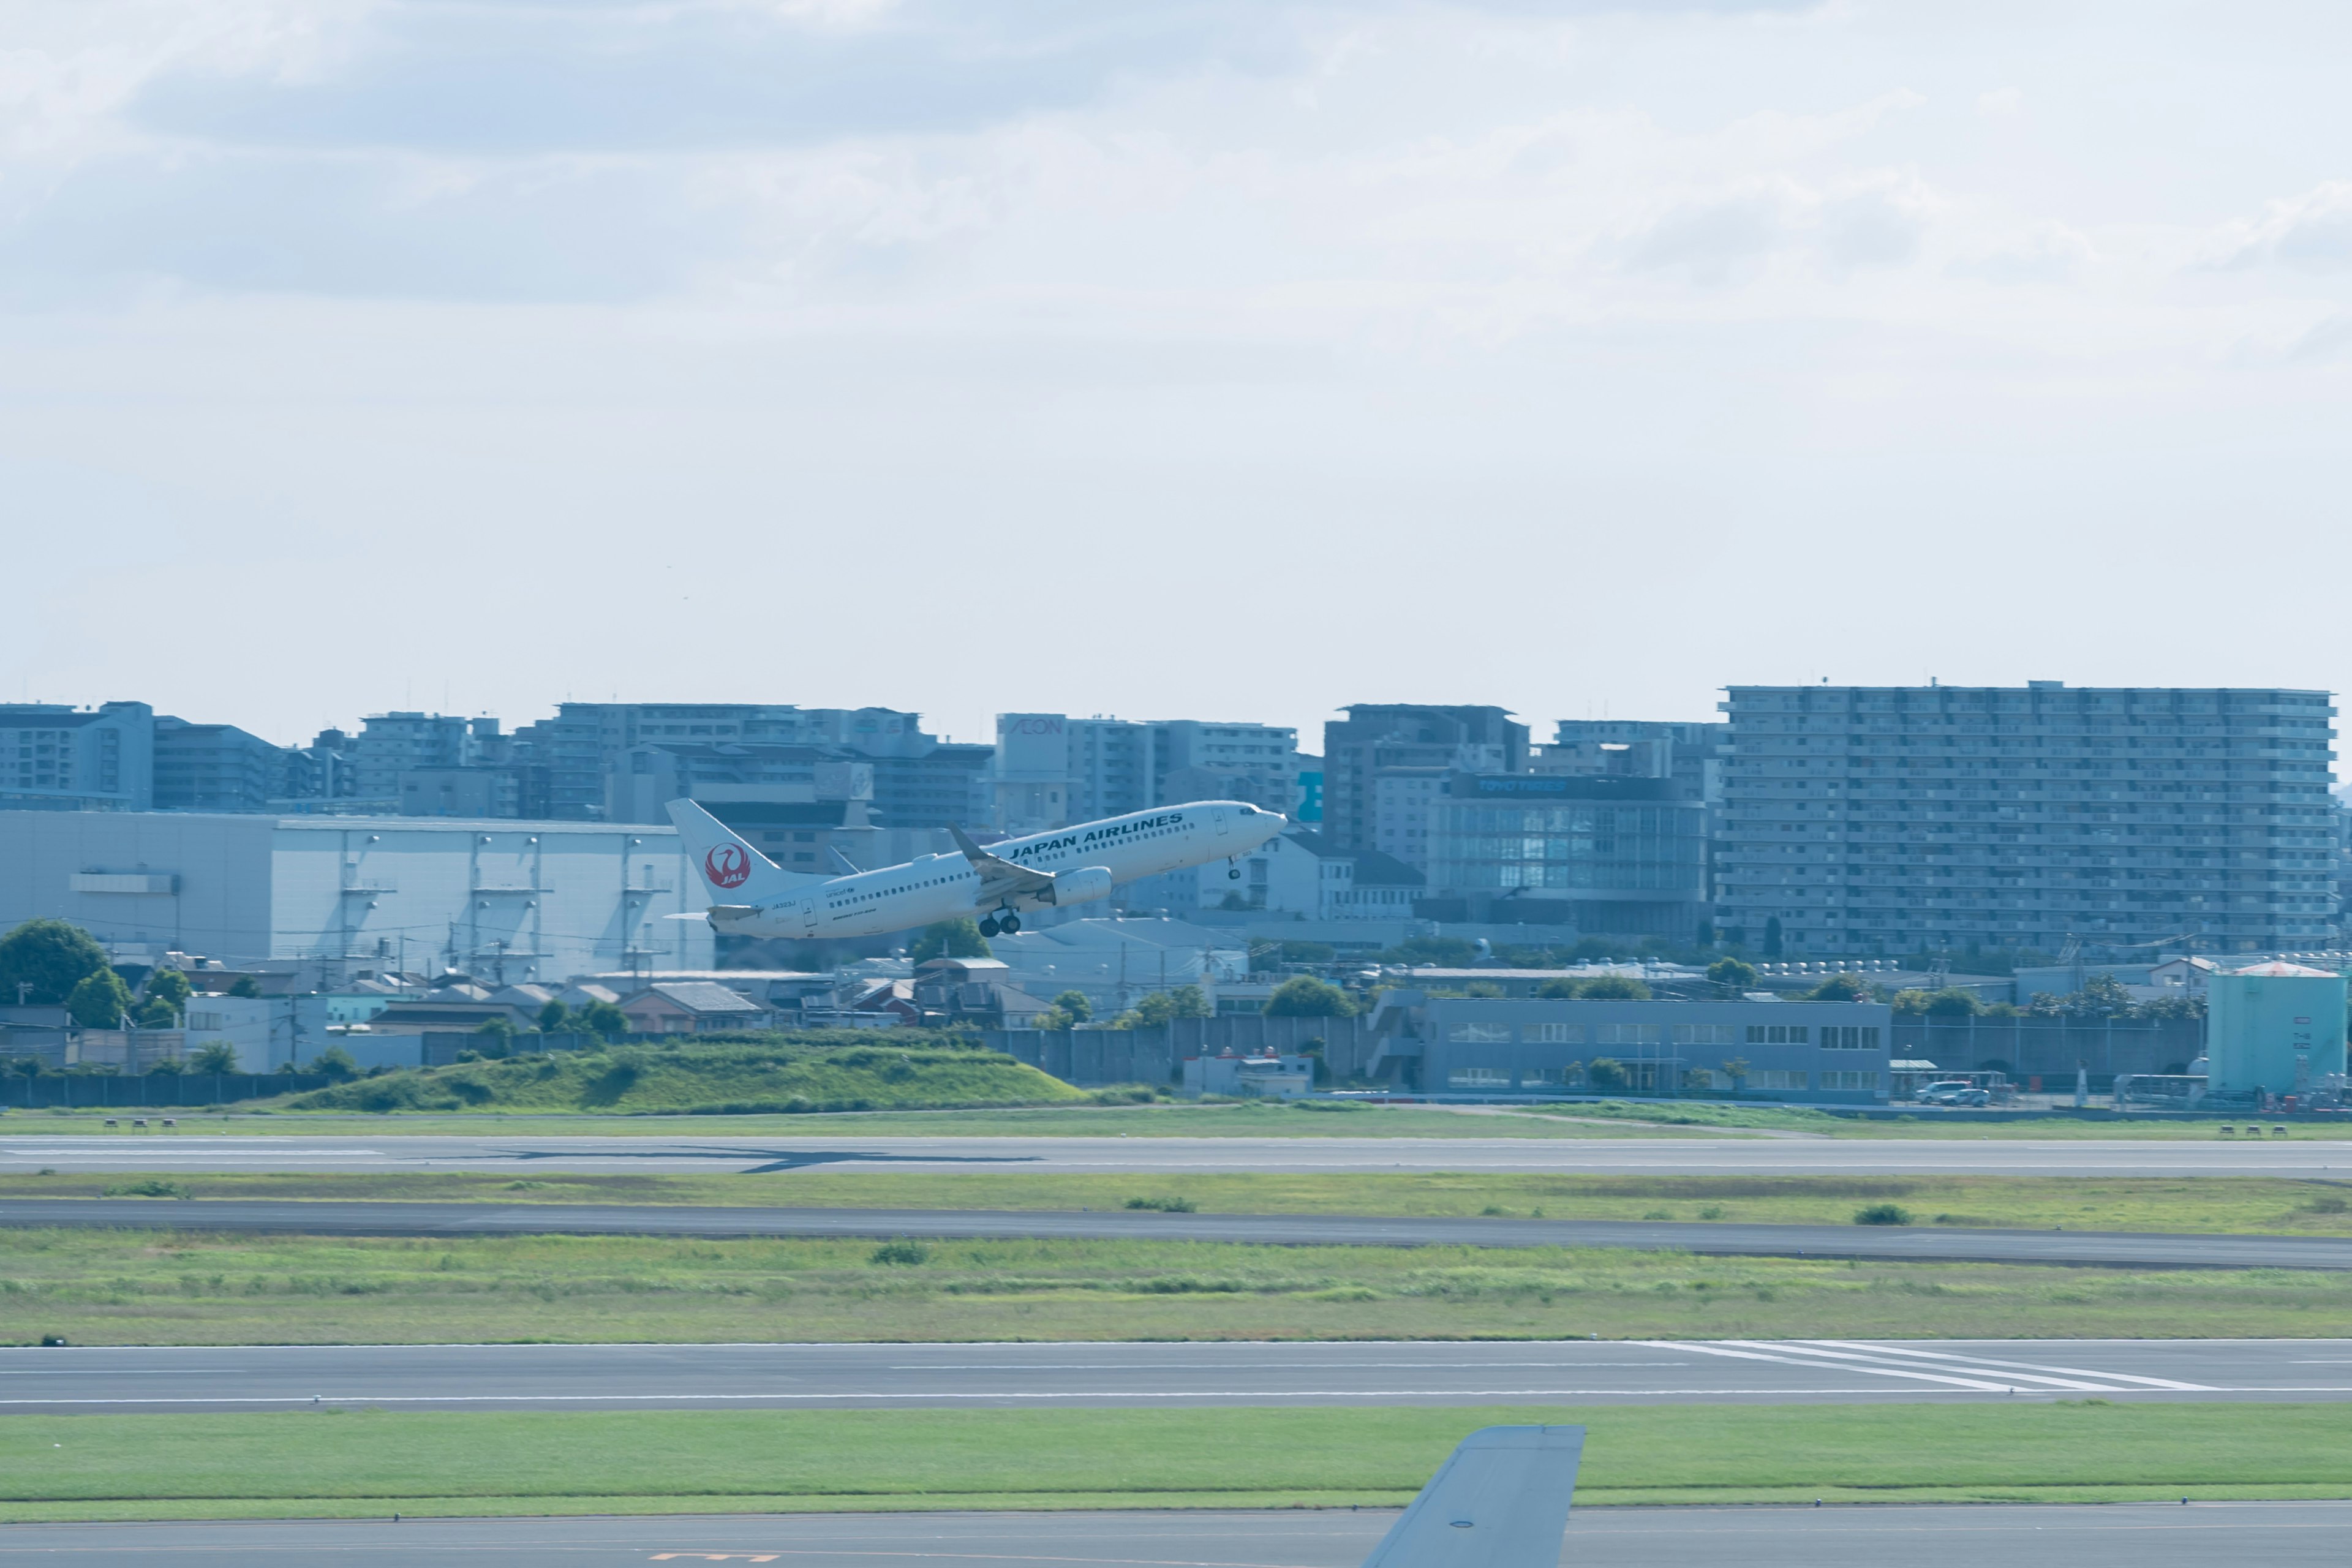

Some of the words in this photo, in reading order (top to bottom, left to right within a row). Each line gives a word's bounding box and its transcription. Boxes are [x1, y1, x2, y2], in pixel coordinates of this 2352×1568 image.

[1009, 835, 1076, 859] JAPAN
[1084, 813, 1183, 843] AIRLINES
[721, 872, 745, 885] JAL
[771, 900, 796, 910] JA323J
